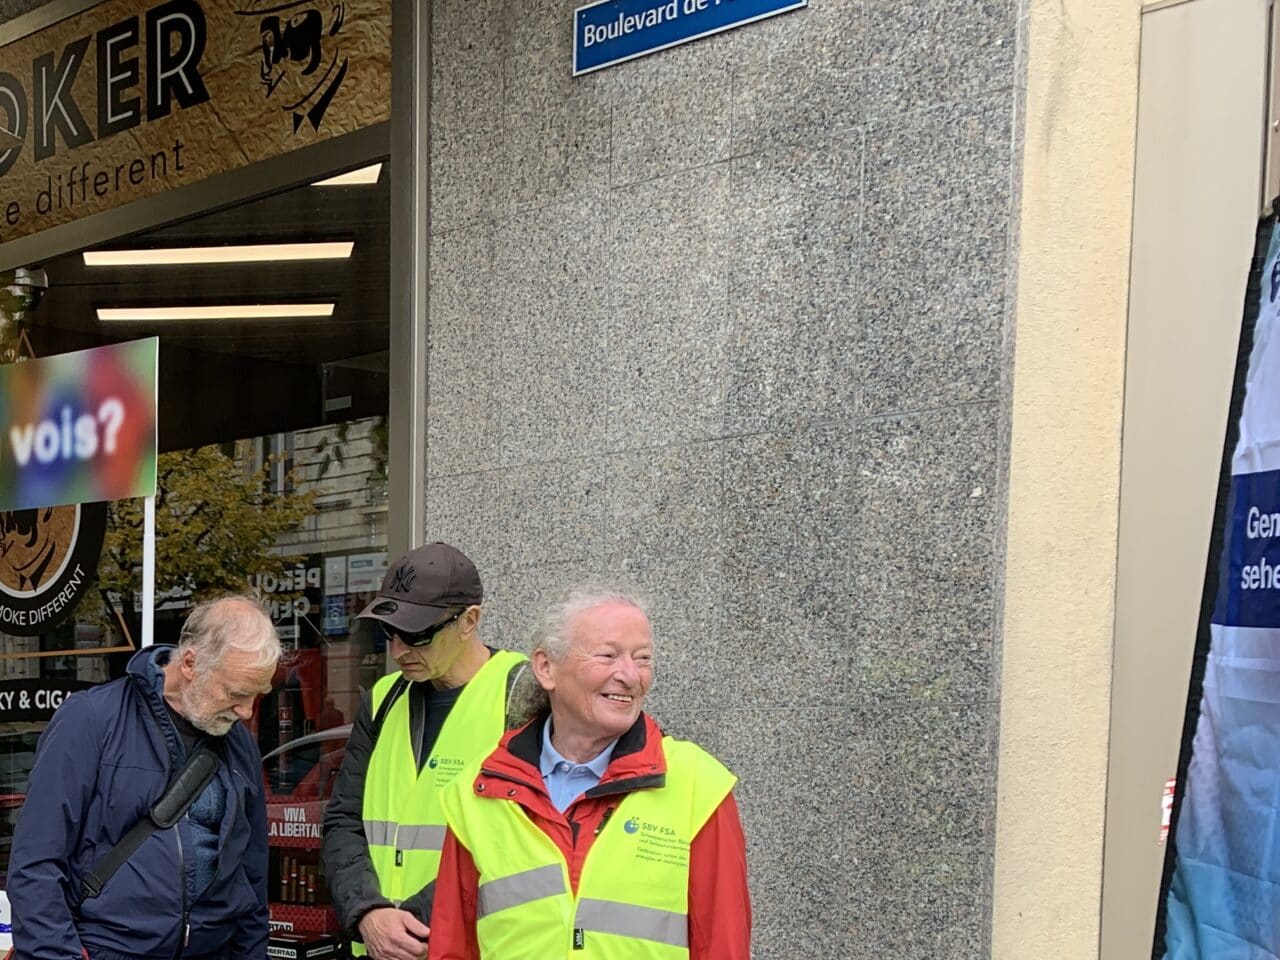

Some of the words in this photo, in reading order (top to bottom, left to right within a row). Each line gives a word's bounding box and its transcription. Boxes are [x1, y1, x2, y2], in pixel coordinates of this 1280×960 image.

[583, 0, 679, 47] Boulevard
[35, 138, 186, 217] different
[10, 397, 125, 466] vois?
[29, 563, 86, 625] DIFFERENT
[18, 689, 32, 710] &
[283, 807, 306, 823] VIVA
[660, 827, 676, 836] FSA
